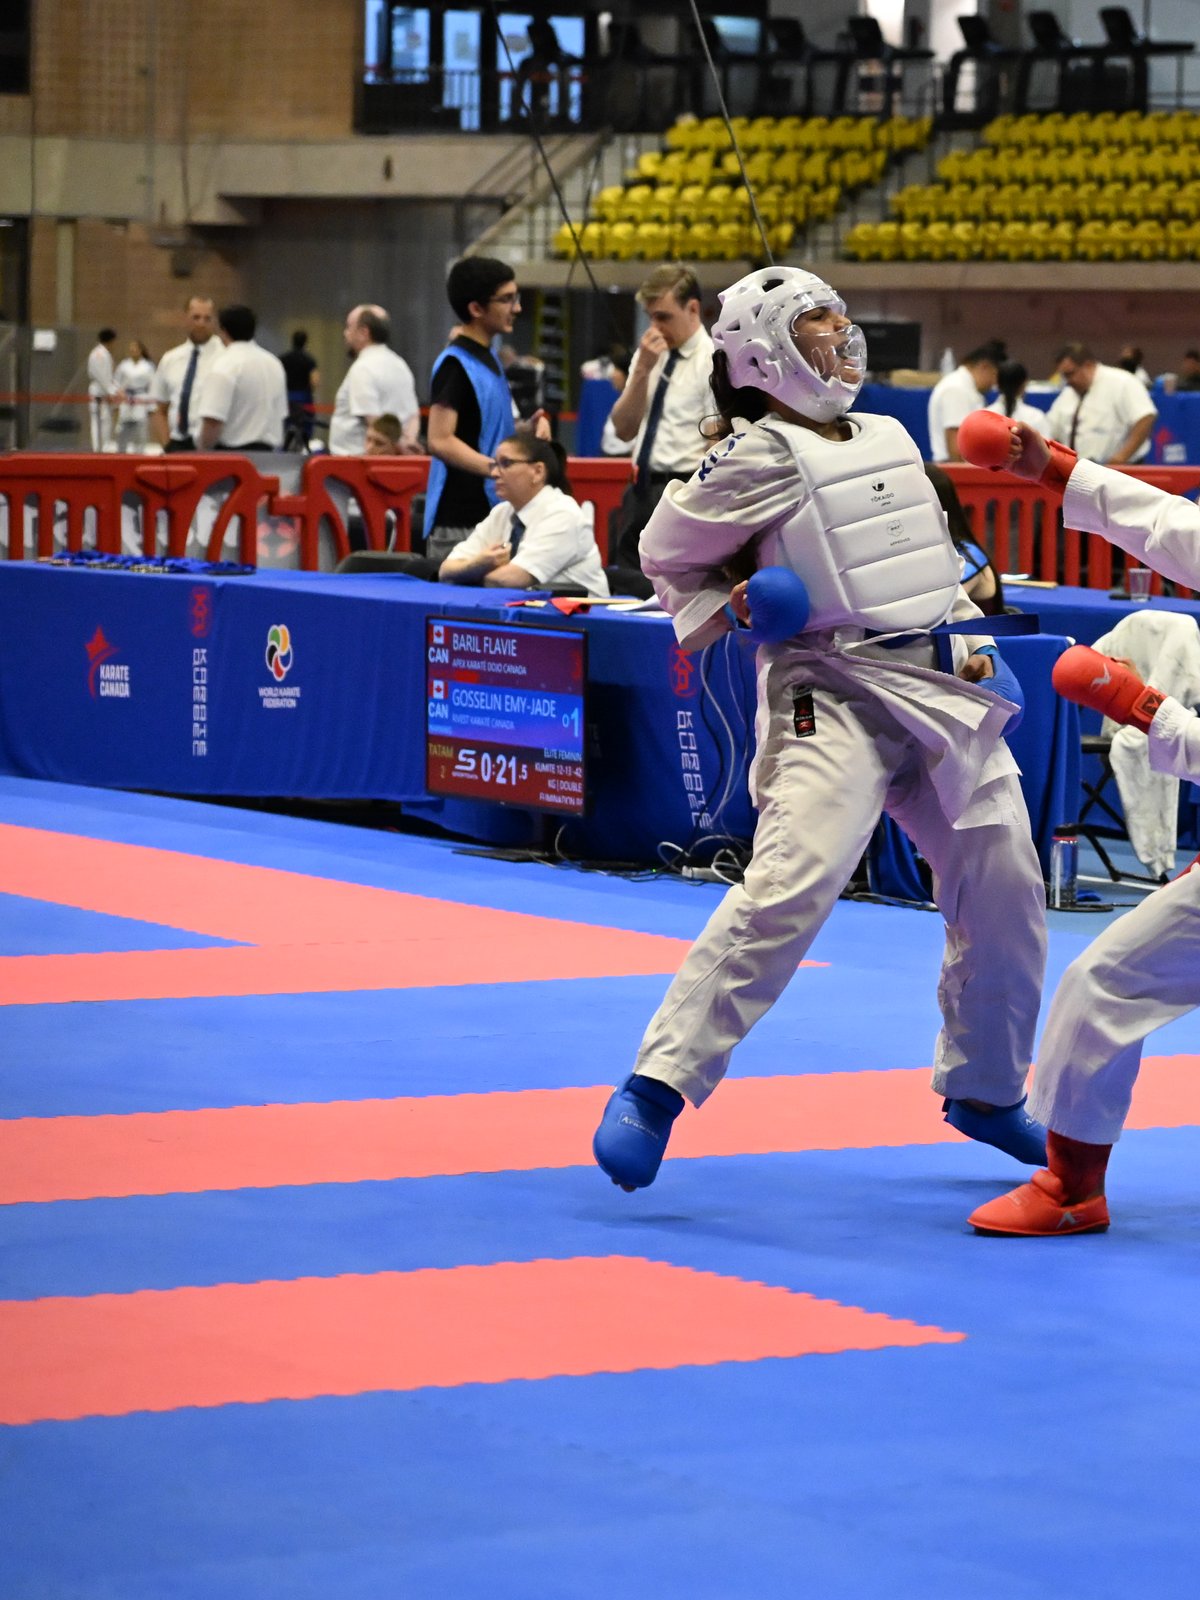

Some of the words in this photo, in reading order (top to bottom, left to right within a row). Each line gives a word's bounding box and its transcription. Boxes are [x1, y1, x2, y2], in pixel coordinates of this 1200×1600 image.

[452, 633, 481, 654] BARIL
[483, 636, 517, 657] FLAVIE
[428, 647, 449, 664] CAN
[100, 665, 130, 681] KARATE
[100, 682, 130, 698] CANADA
[428, 702, 449, 719] CAN
[452, 689, 502, 710] GOSSELIN
[504, 695, 557, 718] EMY-JADE
[571, 708, 579, 737] 1
[535, 762, 556, 774] KUMITE
[560, 780, 583, 793] DOUBLE
